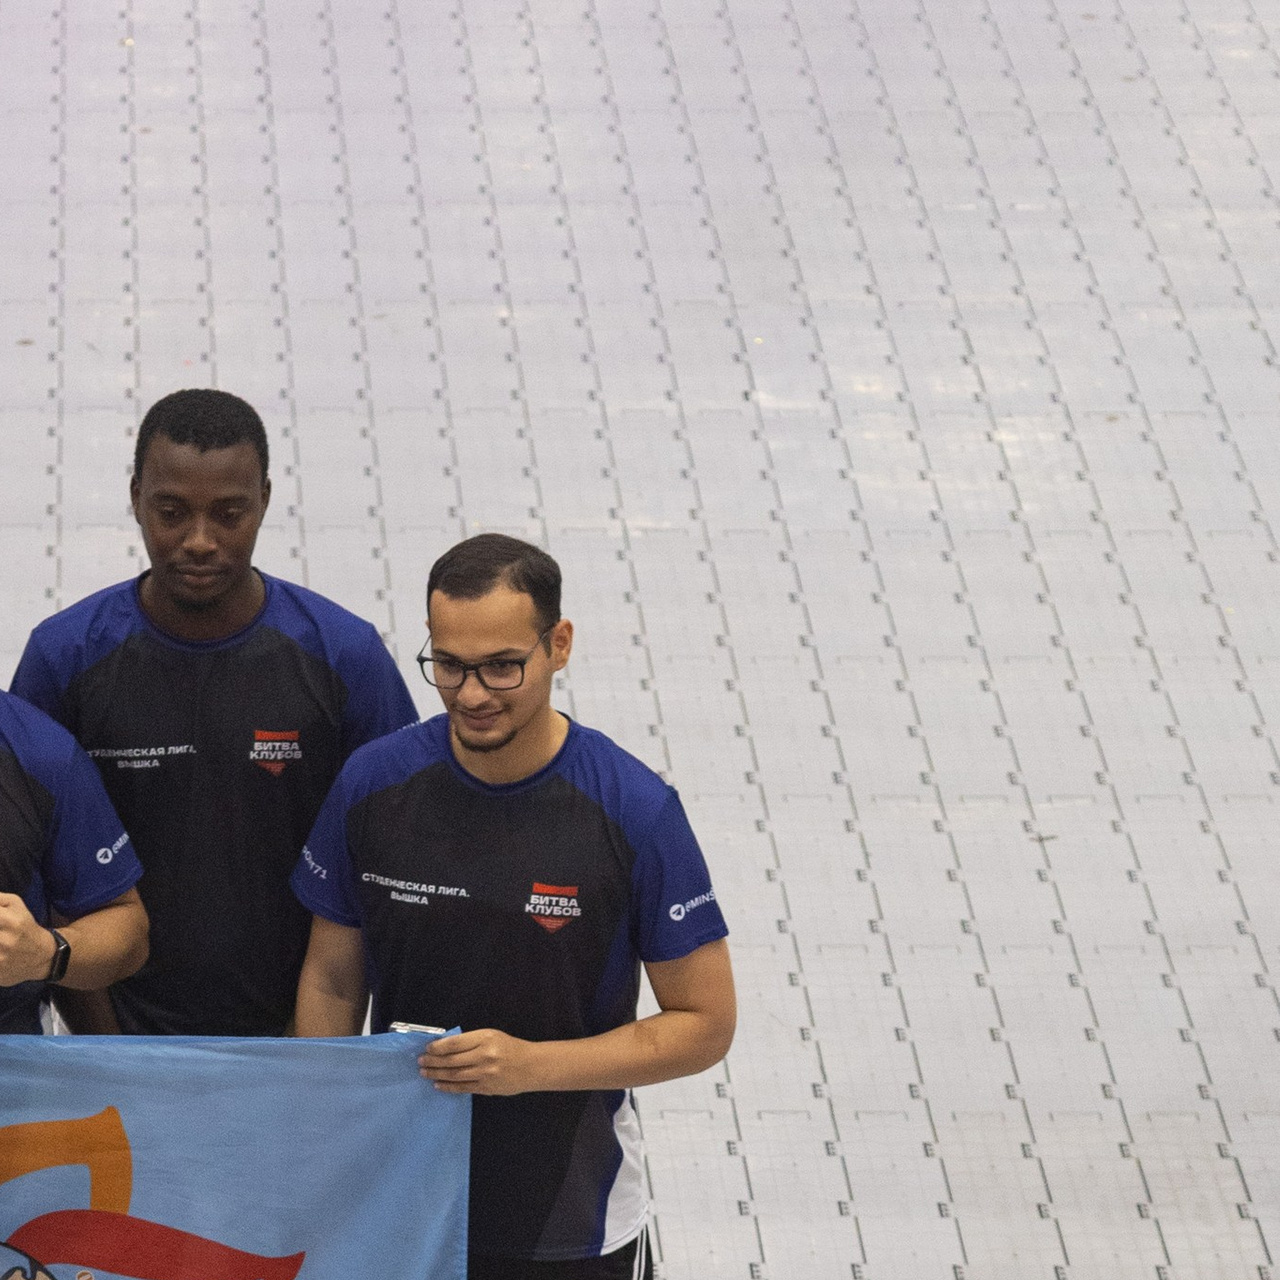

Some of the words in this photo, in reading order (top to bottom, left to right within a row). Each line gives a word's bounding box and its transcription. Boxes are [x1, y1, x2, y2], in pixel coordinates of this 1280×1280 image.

[86, 747, 166, 757] ТУДЕНЧЕСКАЯ
[253, 741, 300, 751] БИТВА
[249, 751, 303, 760] КЛУБОВ
[361, 873, 436, 893] СТУДЕНЧЕСКАЯ
[437, 886, 470, 897] ЛИГА.
[390, 891, 428, 905] ВЫШКА
[530, 894, 578, 907] БИТВА
[524, 903, 582, 916] КЛУБОВ
